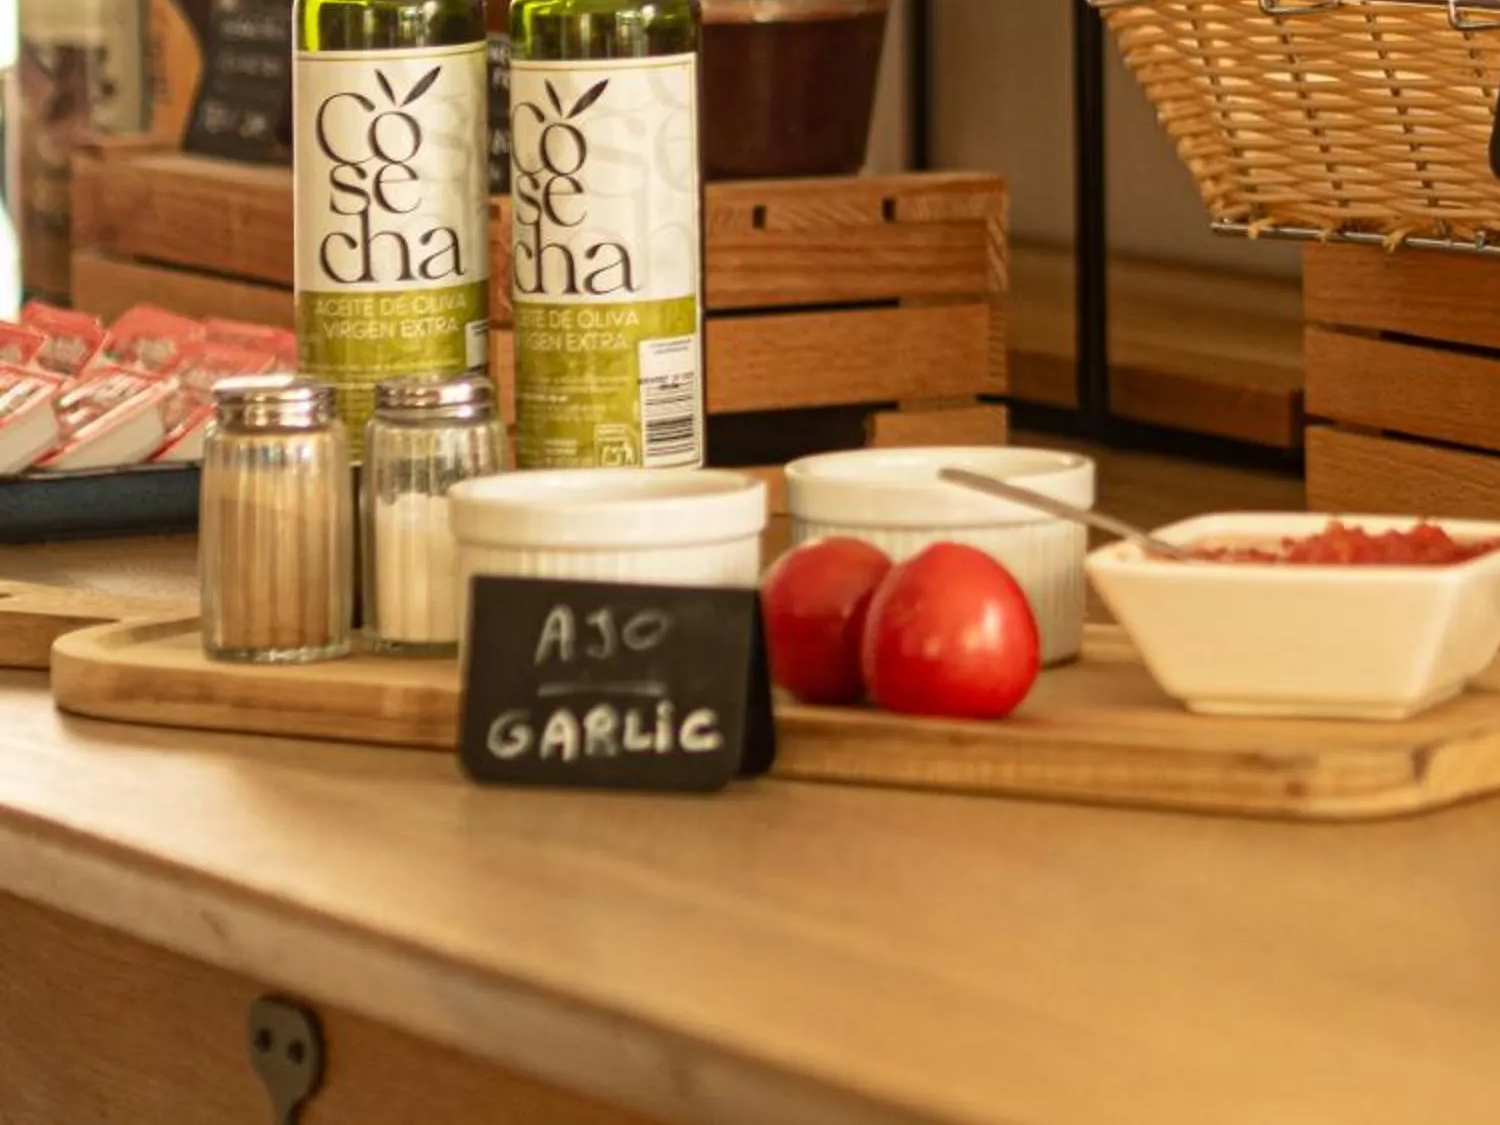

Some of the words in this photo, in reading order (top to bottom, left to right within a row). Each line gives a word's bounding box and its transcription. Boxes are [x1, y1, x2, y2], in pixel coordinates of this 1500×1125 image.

[316, 298, 375, 317] ACEITE
[380, 297, 408, 317] DE
[548, 308, 573, 329] DE
[577, 307, 640, 329] OLIVA
[323, 320, 396, 341] VIRGEN
[401, 316, 460, 339] EXTRA
[566, 330, 629, 353] EXTRA
[533, 604, 674, 666] AJO
